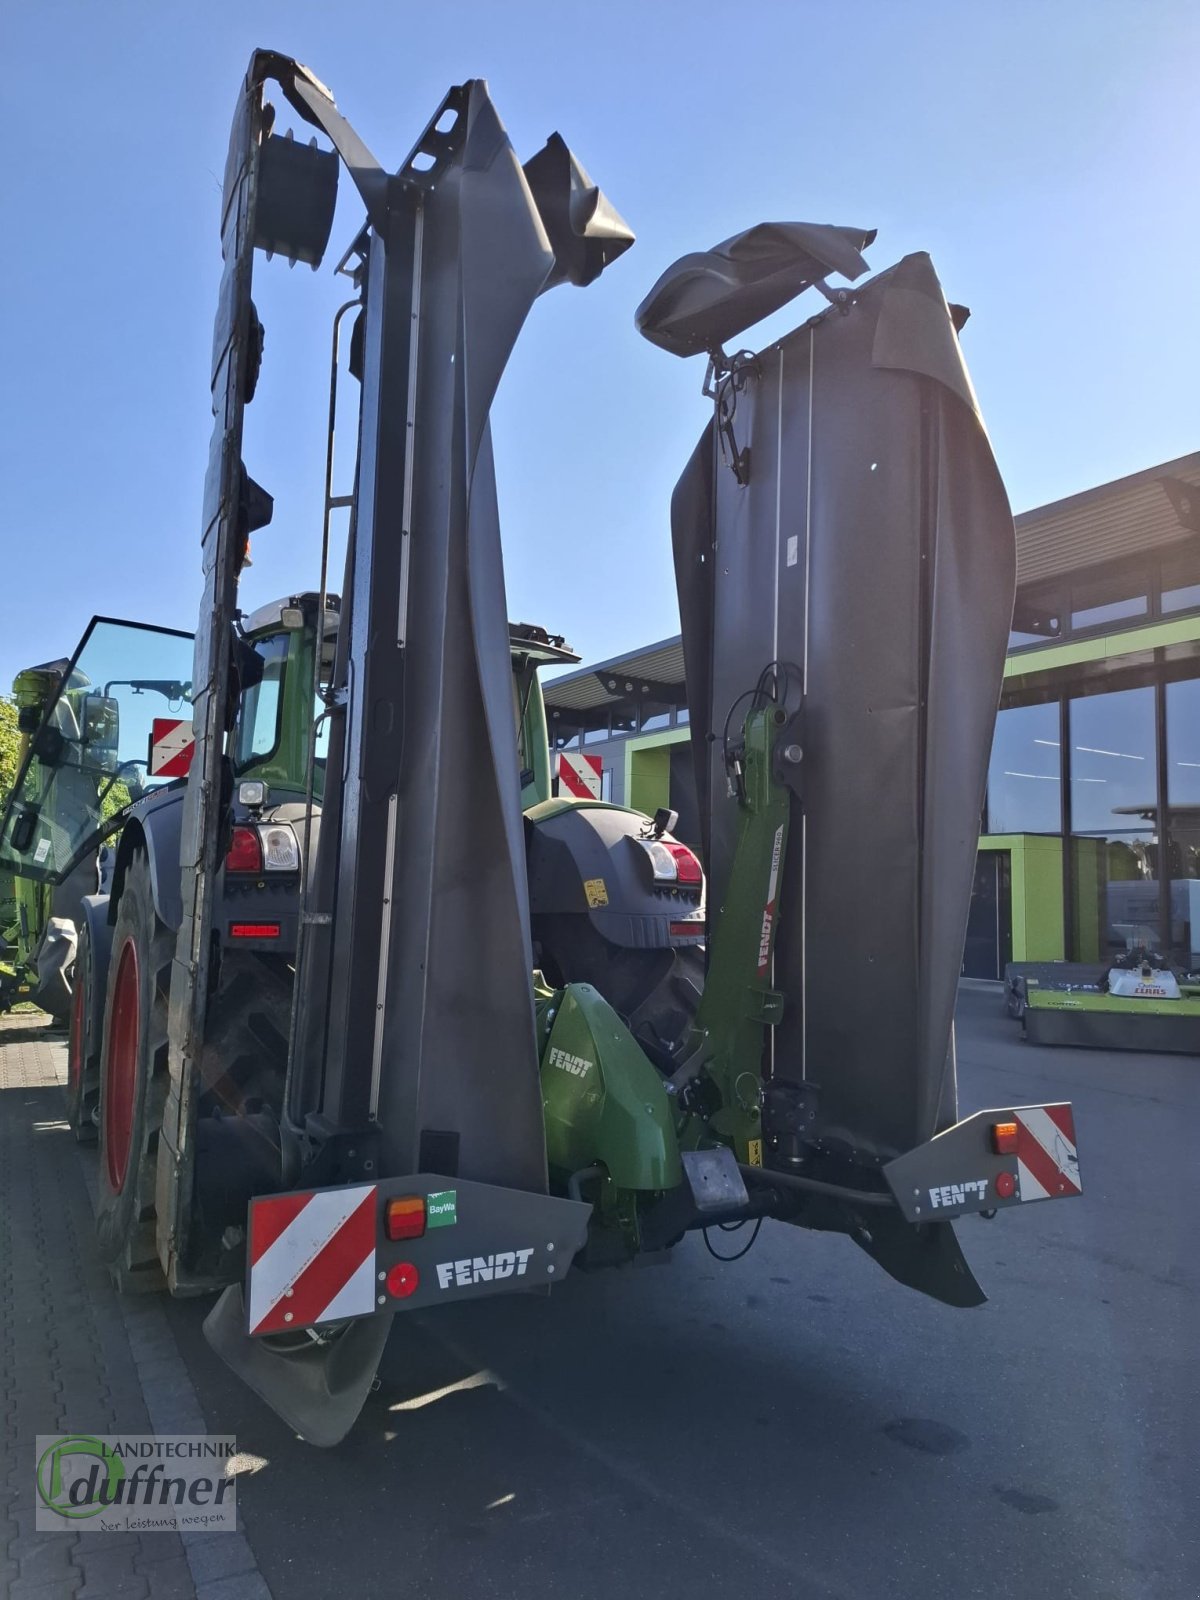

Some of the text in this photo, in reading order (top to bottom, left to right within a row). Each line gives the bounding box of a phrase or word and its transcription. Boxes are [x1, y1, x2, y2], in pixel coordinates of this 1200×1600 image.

[758, 910, 772, 967] FENDT
[548, 1047, 593, 1078] FENDT
[429, 1202, 456, 1214] BayWa
[436, 1248, 534, 1289] FENDT
